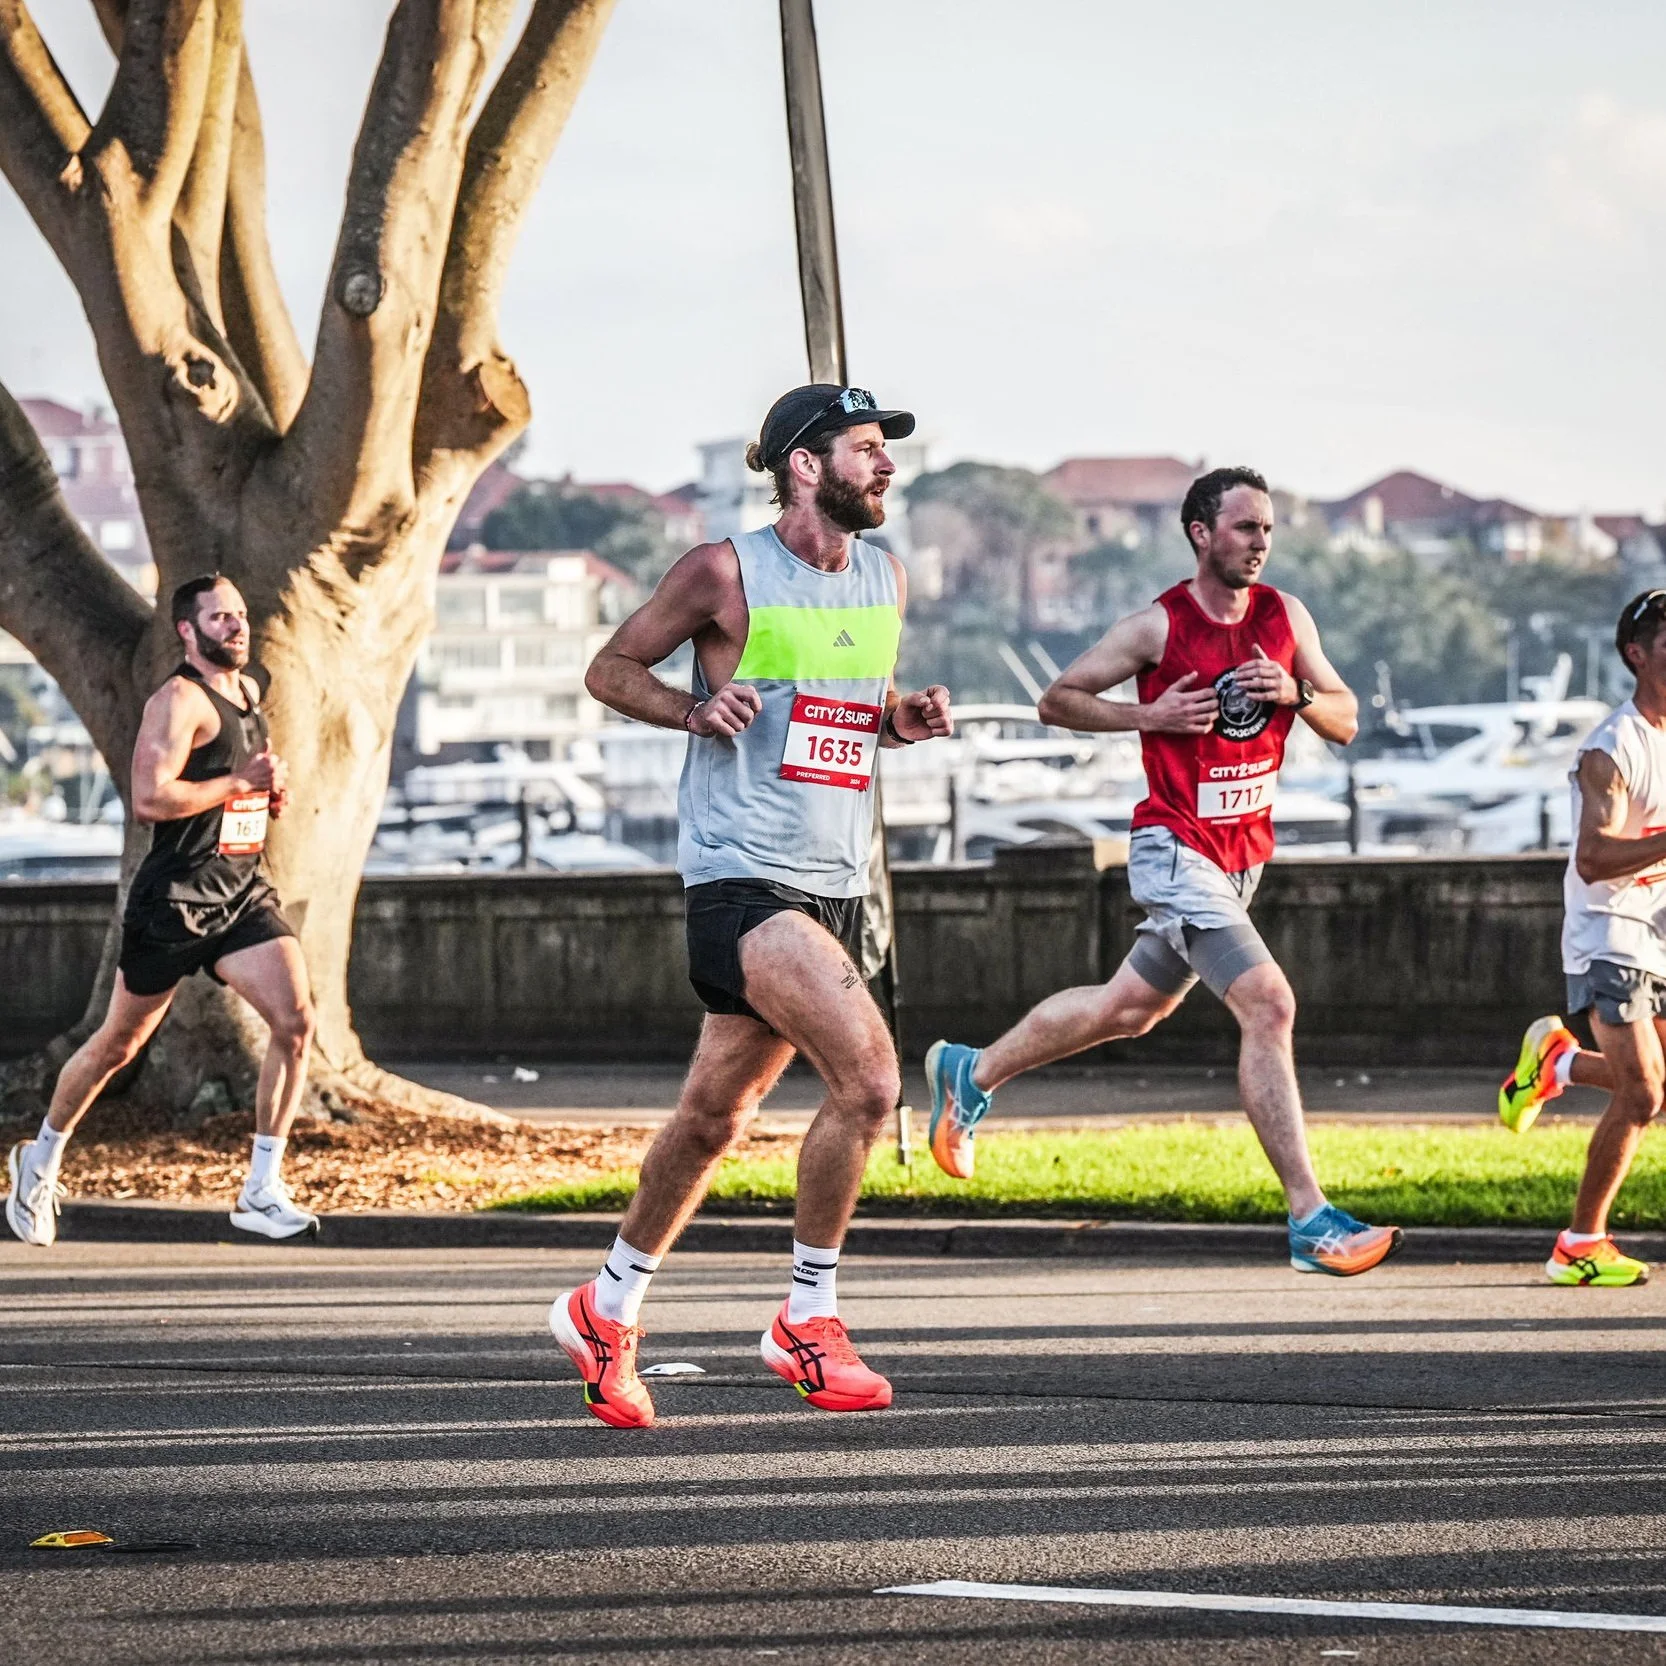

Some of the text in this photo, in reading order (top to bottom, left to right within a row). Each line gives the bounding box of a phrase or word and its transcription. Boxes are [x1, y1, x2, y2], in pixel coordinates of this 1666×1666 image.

[804, 704, 873, 726] CITY2SURF
[808, 736, 863, 767] 1635
[796, 770, 830, 781] PREFERRED
[1209, 758, 1273, 779] CITY2SURF
[1219, 785, 1263, 809] 1717
[801, 1268, 819, 1277] cep
